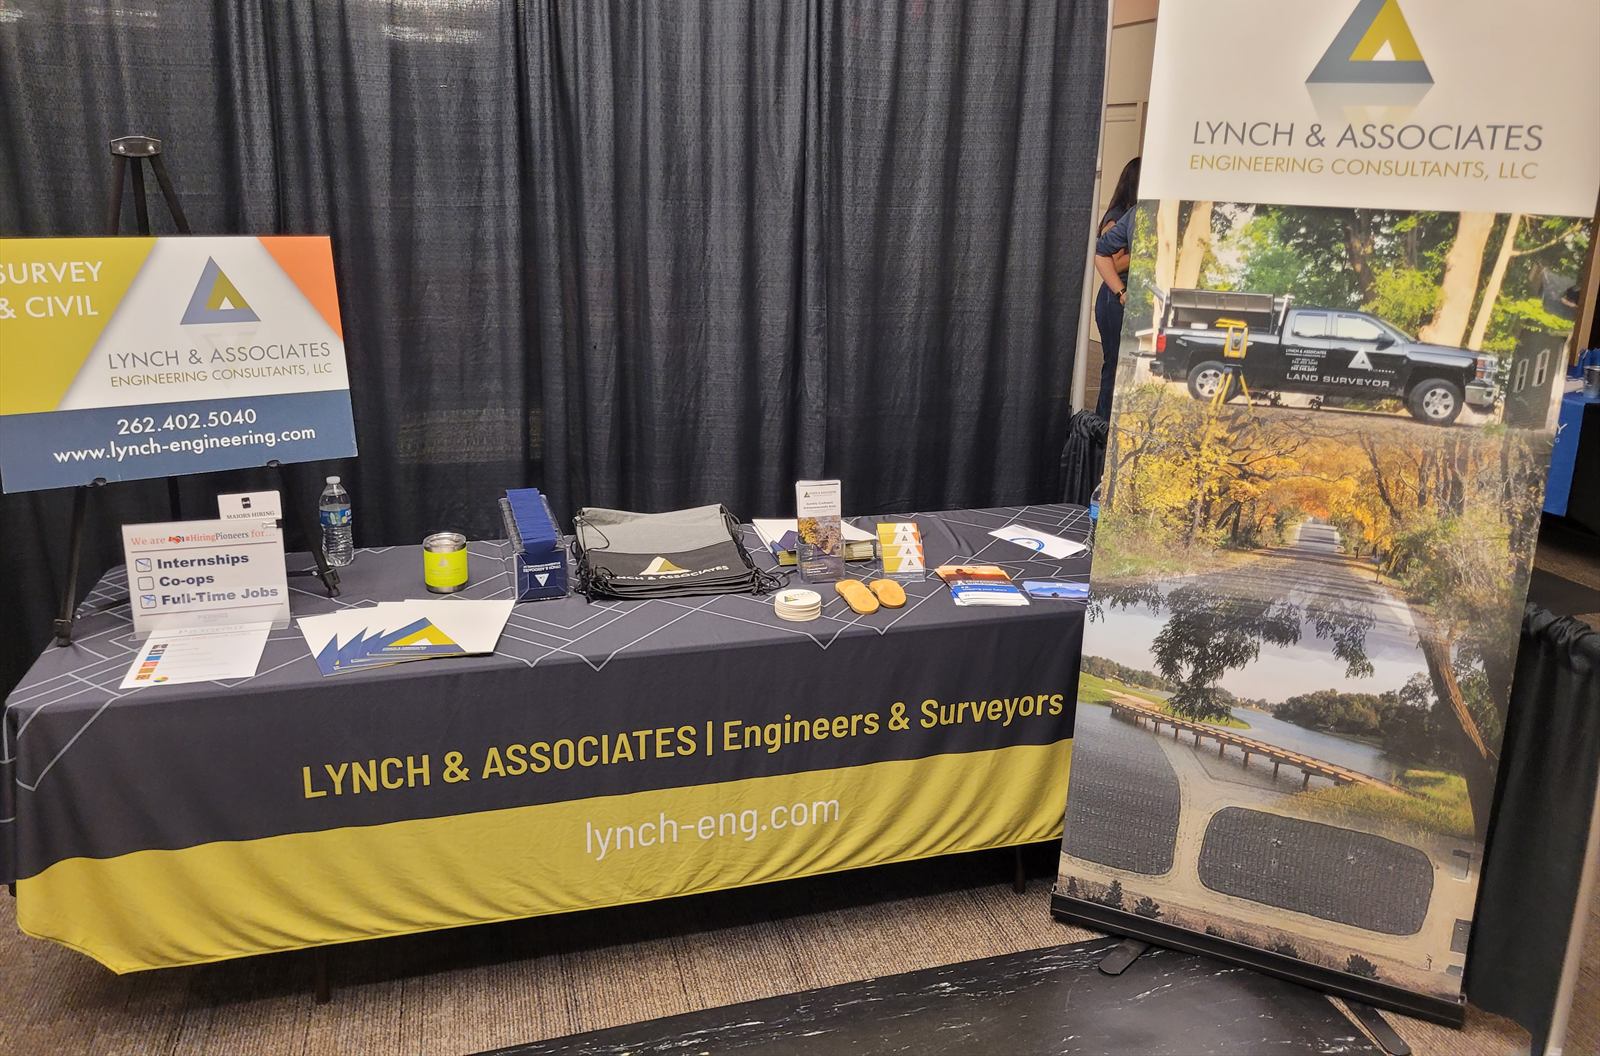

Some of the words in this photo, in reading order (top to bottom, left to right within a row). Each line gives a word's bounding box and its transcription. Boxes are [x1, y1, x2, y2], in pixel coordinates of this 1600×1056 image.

[1192, 121, 1295, 147] LYNCH
[1305, 124, 1326, 147] &
[1336, 124, 1543, 152] ASSOCIATES
[1189, 155, 1324, 174] ENGINEERING
[1331, 158, 1490, 181] CONSULTANTS,
[1498, 162, 1538, 180] LLC
[0, 261, 103, 285] SURVEY
[25, 295, 99, 318] CIVIL
[108, 349, 180, 370] LYNCH
[188, 349, 203, 364] &
[210, 342, 331, 363] ASSOCIATES
[110, 371, 208, 388] ENGINEERING
[212, 364, 310, 381] CONSULTANTS,
[313, 362, 333, 374] LLC
[1286, 373, 1319, 382] LAND
[1322, 375, 1391, 388] SURVEYOR
[116, 408, 258, 436] 262.402.5040
[53, 427, 317, 463] www.lynch-engineering.com
[131, 537, 147, 545] We
[157, 553, 249, 569] Internships
[159, 574, 215, 588] Co-ops
[162, 591, 236, 605] Full-Time
[241, 587, 279, 599] Jobs
[303, 754, 431, 798] LYNCH
[443, 751, 470, 783] &
[482, 725, 697, 779] ASSOCIATES
[723, 712, 880, 754] Engineers
[888, 701, 911, 732] &
[920, 692, 1064, 729] Surveyors
[585, 799, 841, 861] lynch-eng.com
